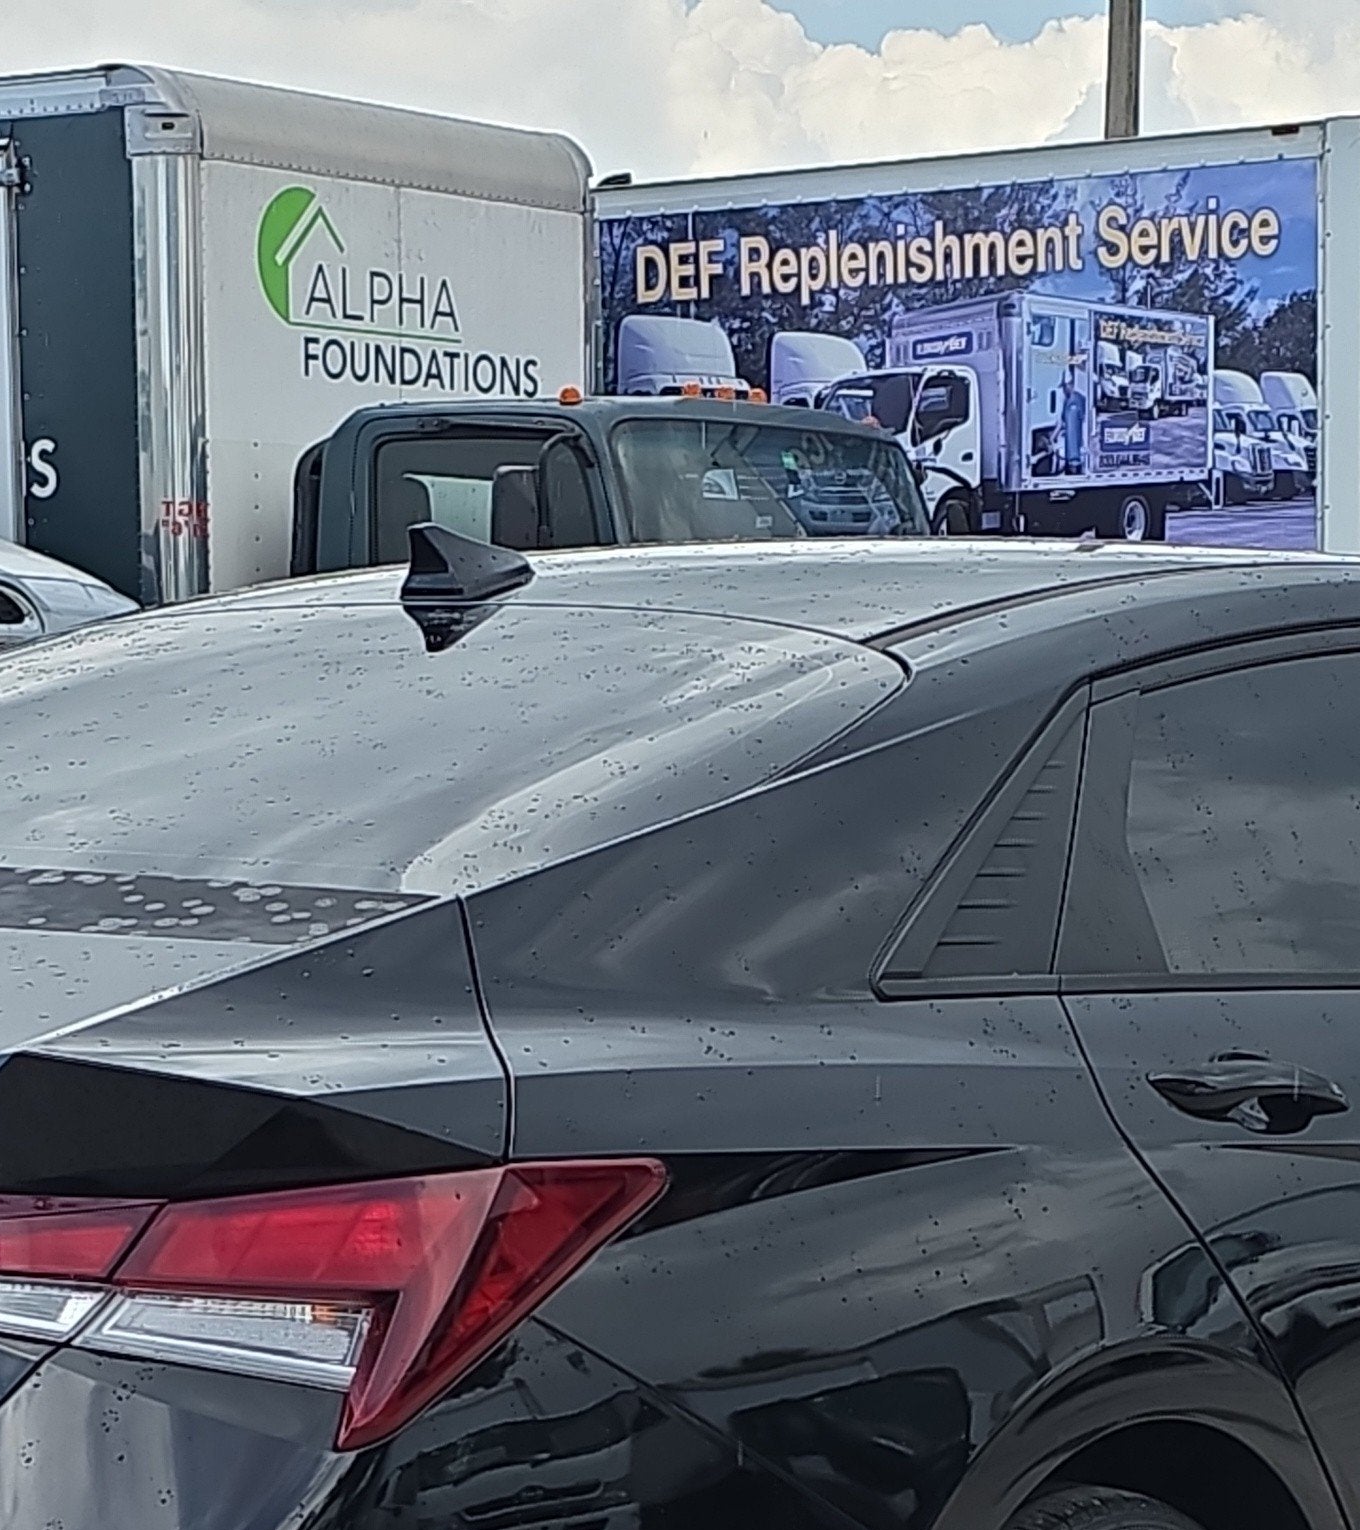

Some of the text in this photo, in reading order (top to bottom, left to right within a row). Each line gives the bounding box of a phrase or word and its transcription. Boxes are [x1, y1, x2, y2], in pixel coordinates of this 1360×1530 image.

[635, 196, 1280, 306] DEF Replenishment Service
[304, 263, 460, 332] ALPHA
[303, 336, 539, 398] FOUNDATIONS
